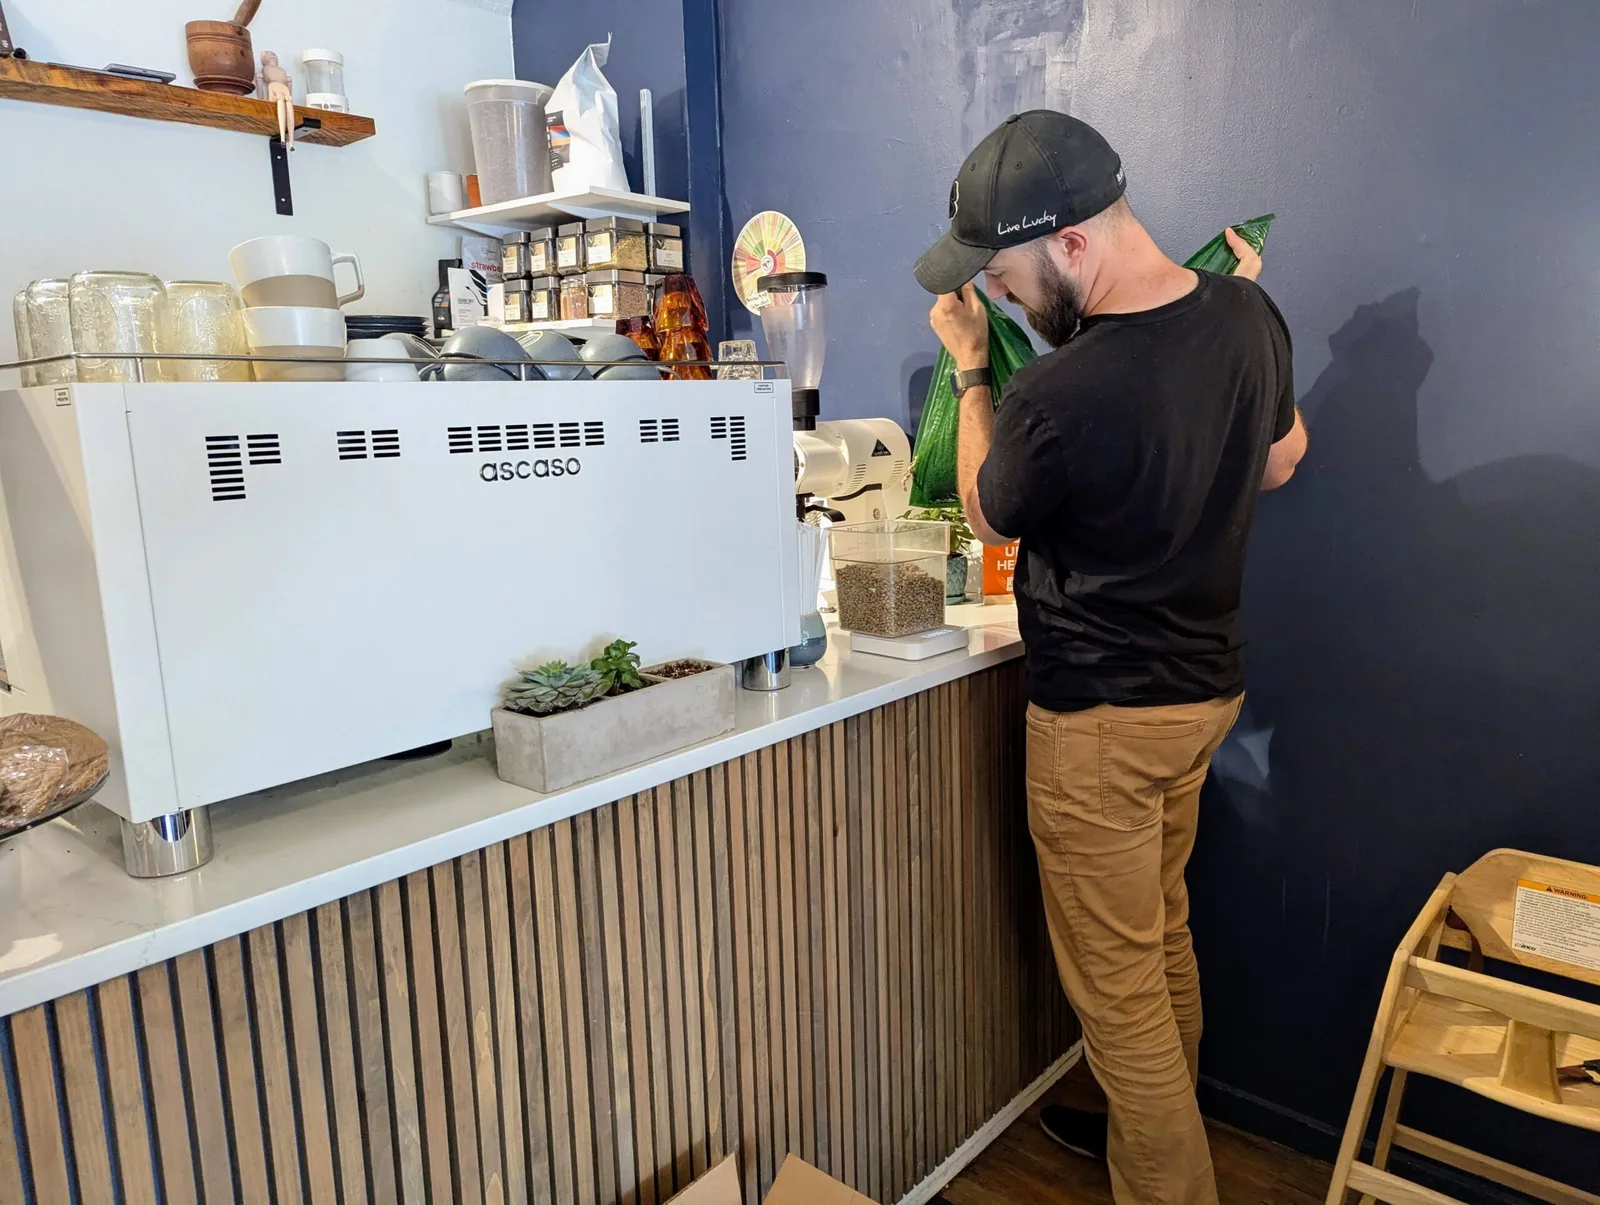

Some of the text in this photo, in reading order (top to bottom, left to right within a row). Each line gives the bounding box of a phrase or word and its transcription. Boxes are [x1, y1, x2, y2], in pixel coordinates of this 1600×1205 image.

[997, 210, 1057, 235] Live Lucky
[480, 457, 581, 482] ascaso
